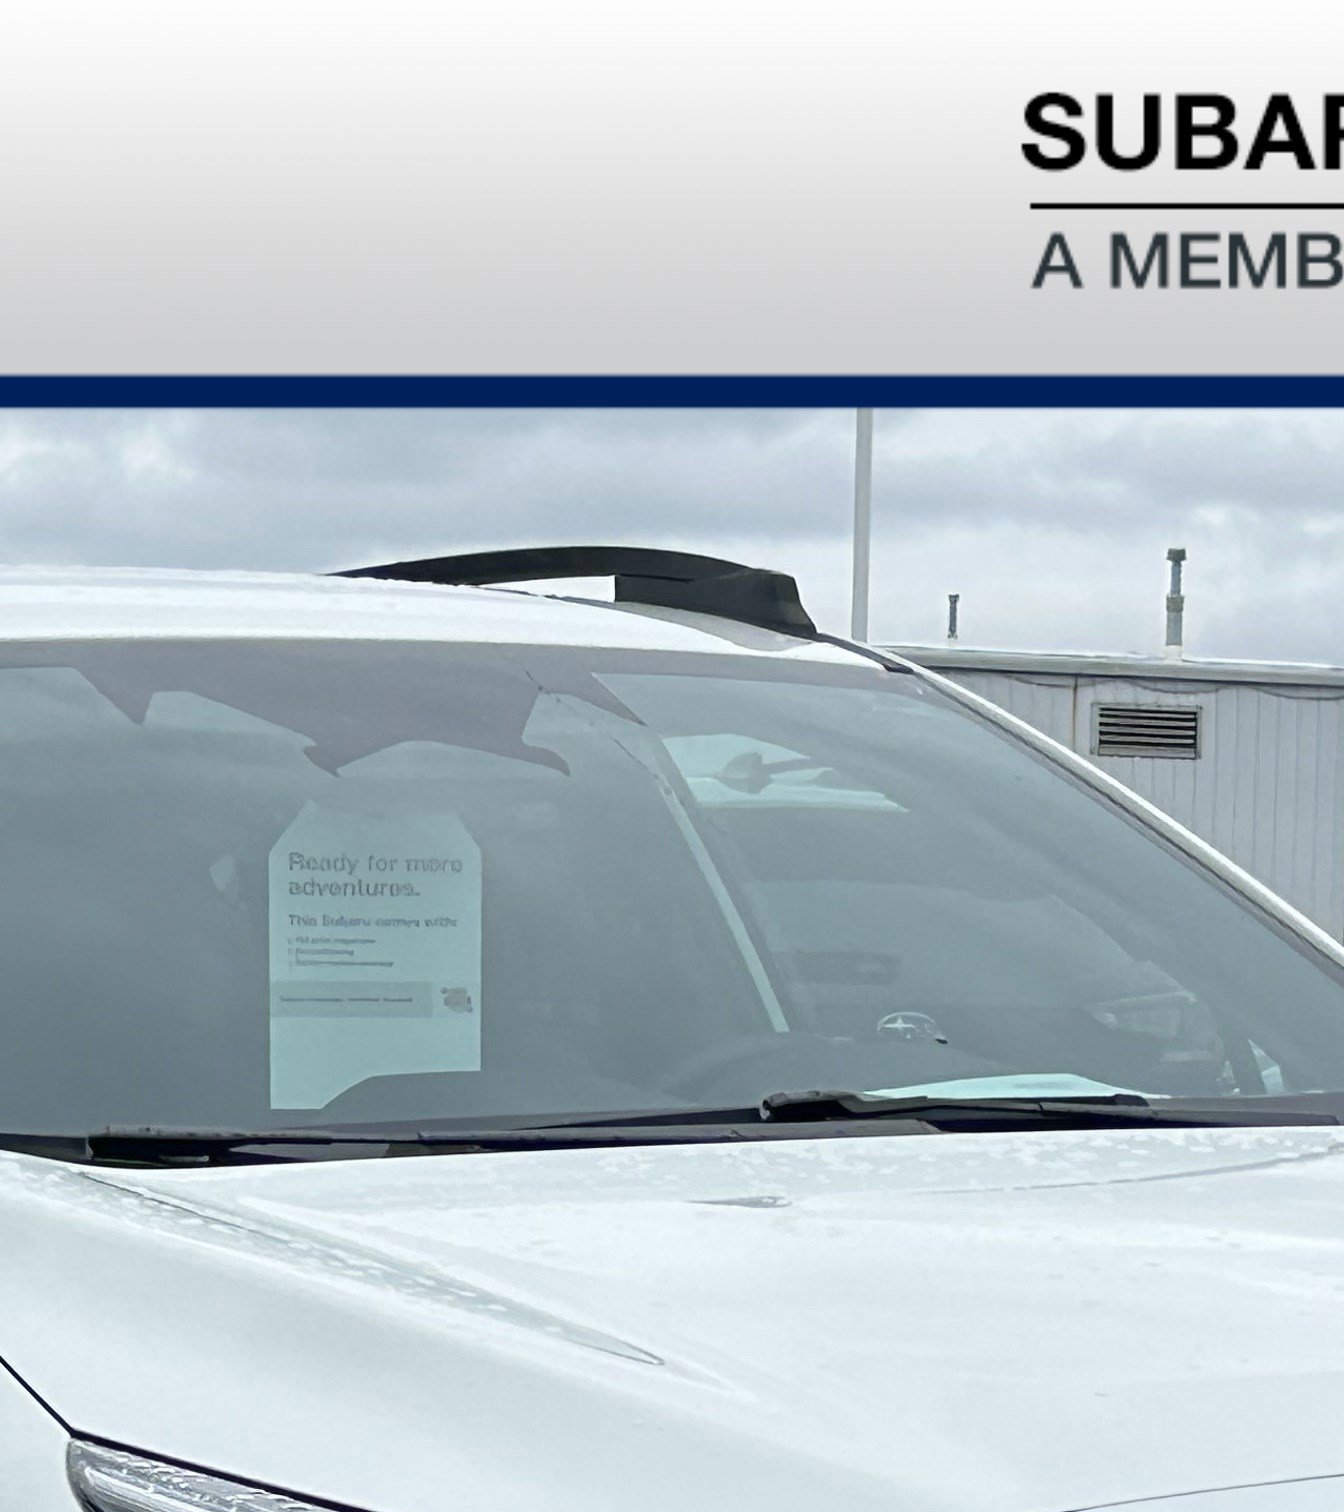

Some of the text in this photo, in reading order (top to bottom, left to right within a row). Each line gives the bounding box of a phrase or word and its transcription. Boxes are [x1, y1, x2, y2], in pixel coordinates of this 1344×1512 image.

[288, 852, 463, 875] Ready for more
[288, 878, 421, 897] adventures.
